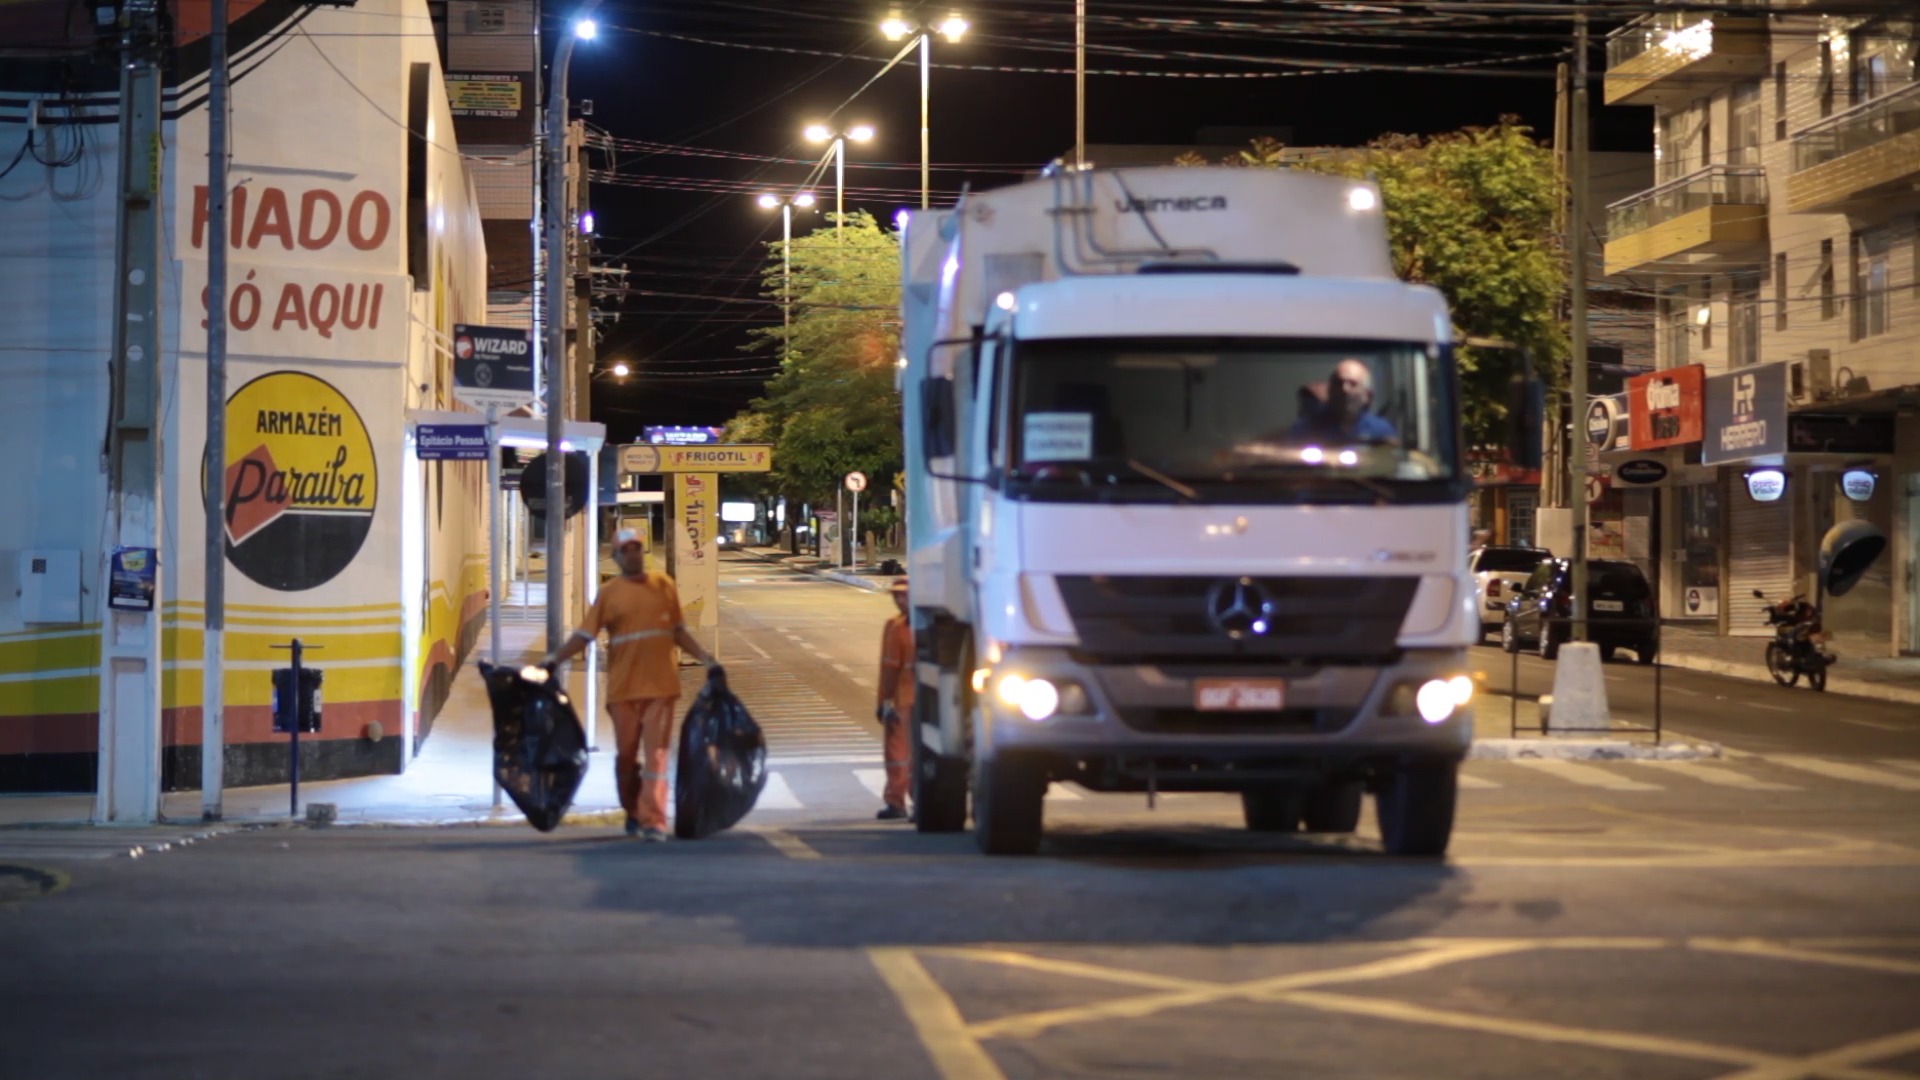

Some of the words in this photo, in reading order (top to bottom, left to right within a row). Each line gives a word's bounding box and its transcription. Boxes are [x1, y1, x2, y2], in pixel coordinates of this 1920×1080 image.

[272, 283, 383, 339] AQUI
[474, 337, 528, 355] WIZARD
[256, 406, 342, 437] ARMAZÉM
[686, 451, 747, 462] FRIGOTIL
